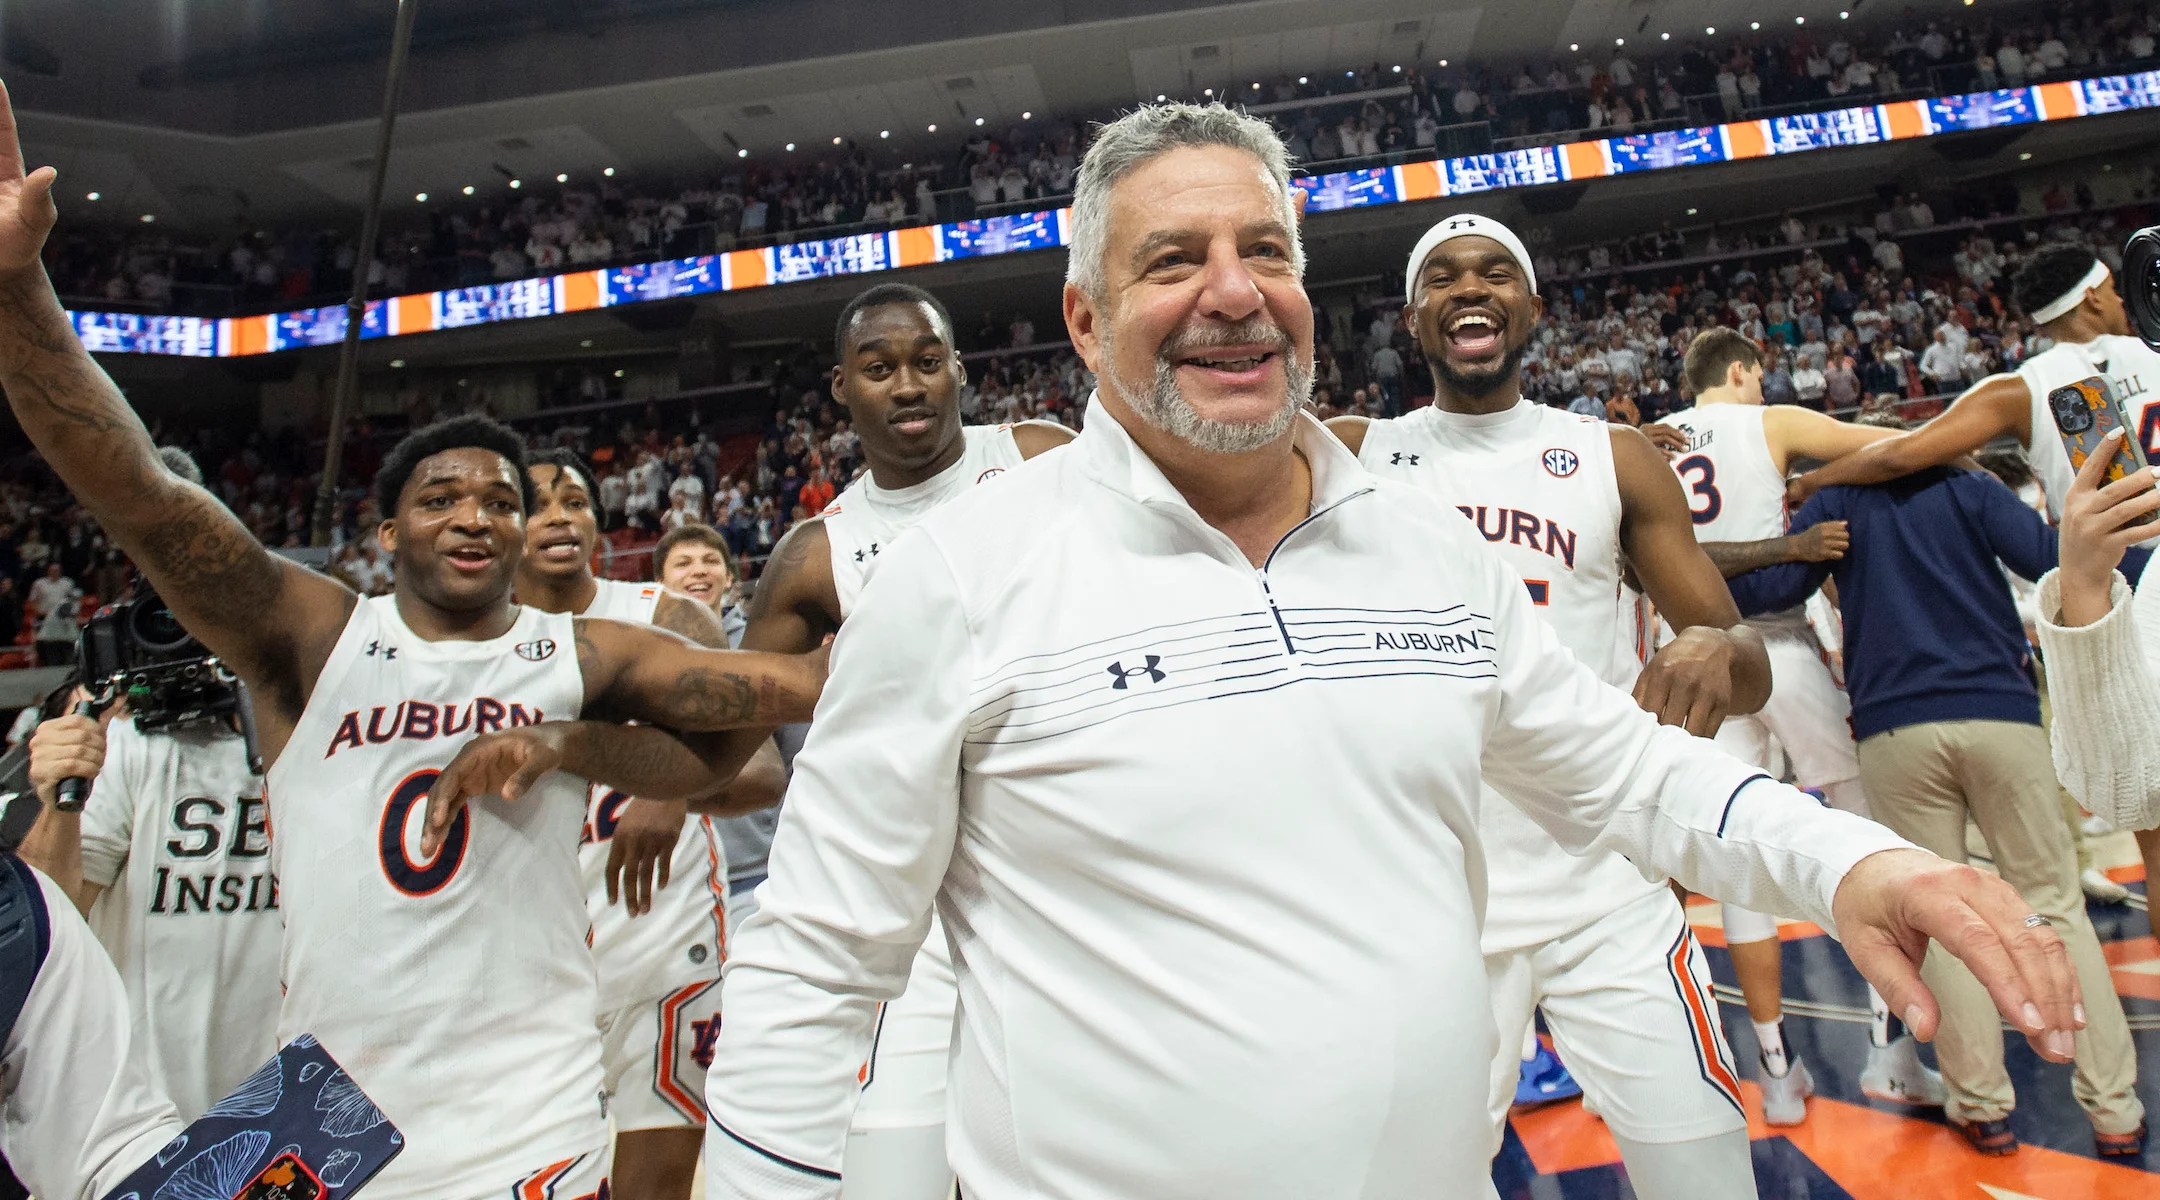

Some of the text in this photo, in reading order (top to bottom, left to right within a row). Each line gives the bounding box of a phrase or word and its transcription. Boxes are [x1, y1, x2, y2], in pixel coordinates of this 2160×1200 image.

[1542, 448, 1579, 478] SEC
[1676, 454, 1721, 525] 3
[1375, 630, 1479, 653] AUBURN
[324, 696, 545, 760] AUBURN
[378, 768, 470, 897] 0
